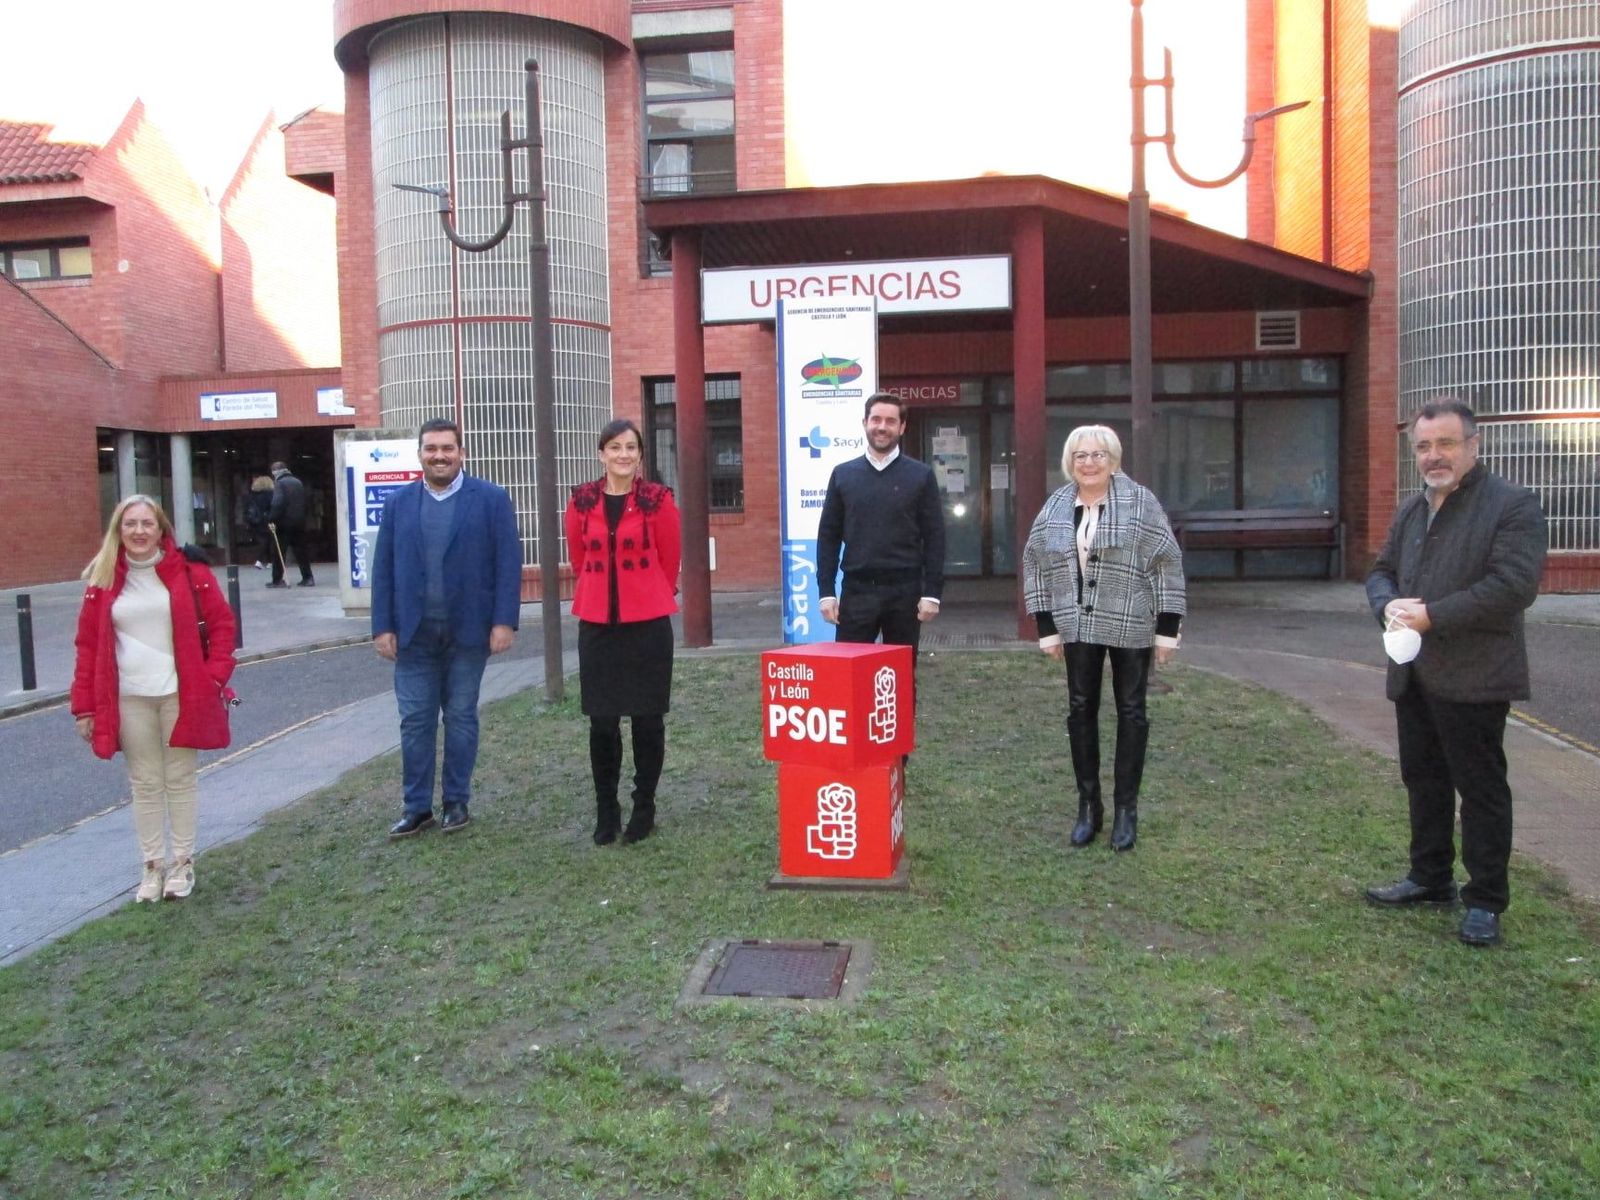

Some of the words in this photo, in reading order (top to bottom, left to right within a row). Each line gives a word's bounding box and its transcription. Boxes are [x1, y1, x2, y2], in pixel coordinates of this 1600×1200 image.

[750, 270, 961, 307] URGENCIAS
[833, 437, 863, 449] Sacyl
[368, 473, 405, 481] URGENCIAS
[800, 489, 818, 497] Base
[351, 531, 370, 581] Sacyl
[783, 544, 815, 636] Sacyl
[768, 661, 814, 681] Castilla
[769, 684, 777, 701] y
[780, 681, 810, 700] León
[768, 704, 848, 745] PSOE
